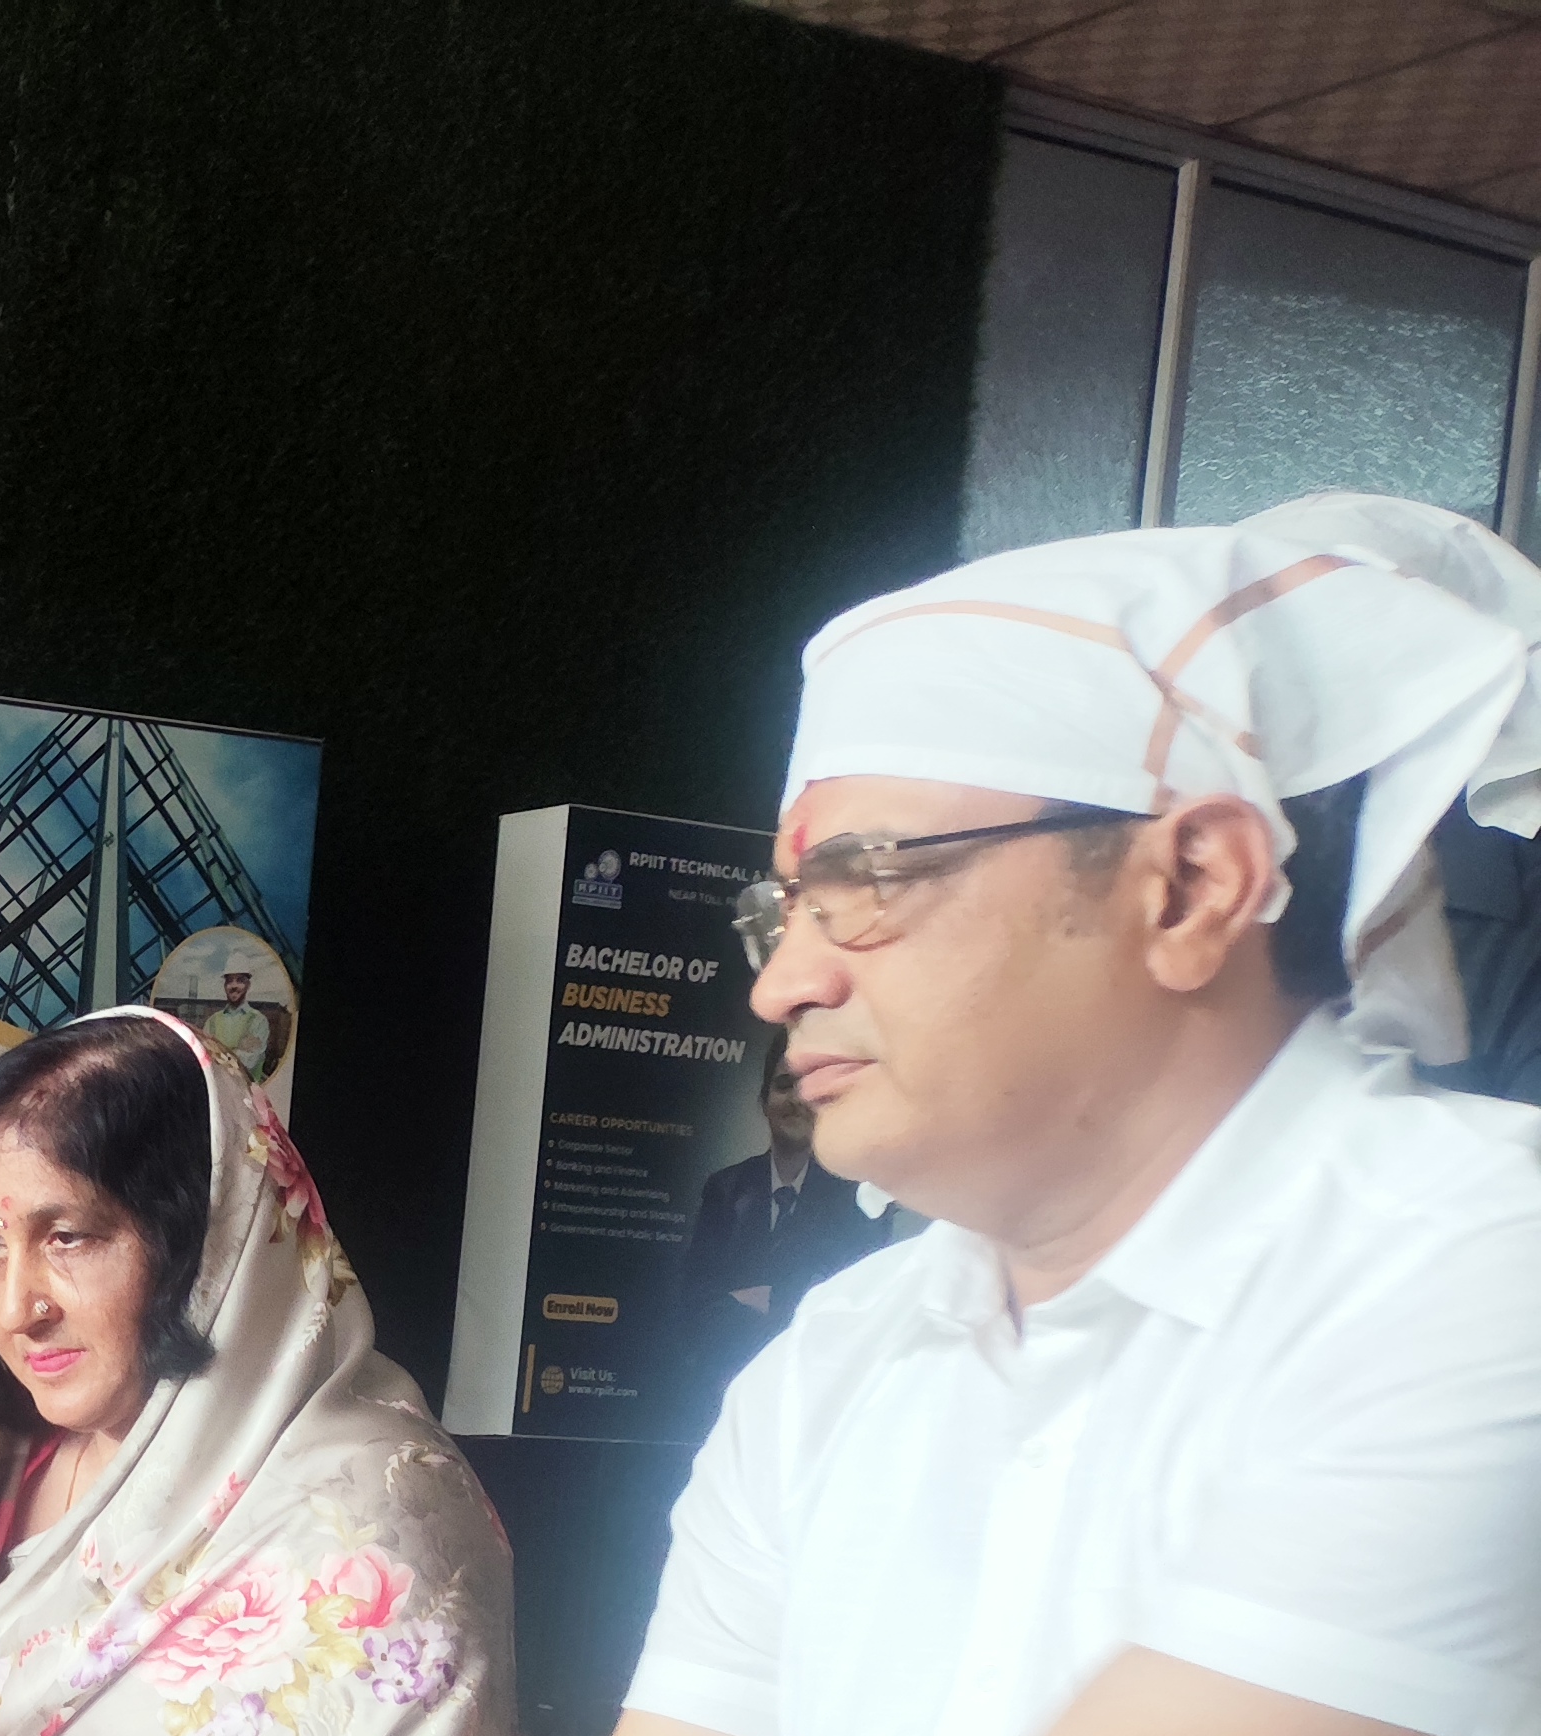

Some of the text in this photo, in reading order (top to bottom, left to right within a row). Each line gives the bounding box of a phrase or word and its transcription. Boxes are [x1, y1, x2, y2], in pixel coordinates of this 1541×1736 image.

[629, 851, 667, 869] RPIIT
[669, 858, 749, 882] TECHNICAL
[565, 943, 719, 984] BACHELOR OF
[562, 982, 672, 1017] BUSINESS
[557, 1021, 746, 1063] ADMINISTRATION
[549, 1112, 695, 1137] CAREER OPPORTUNITIES
[547, 1300, 616, 1317] Enroll Now
[570, 1367, 596, 1381] Visit
